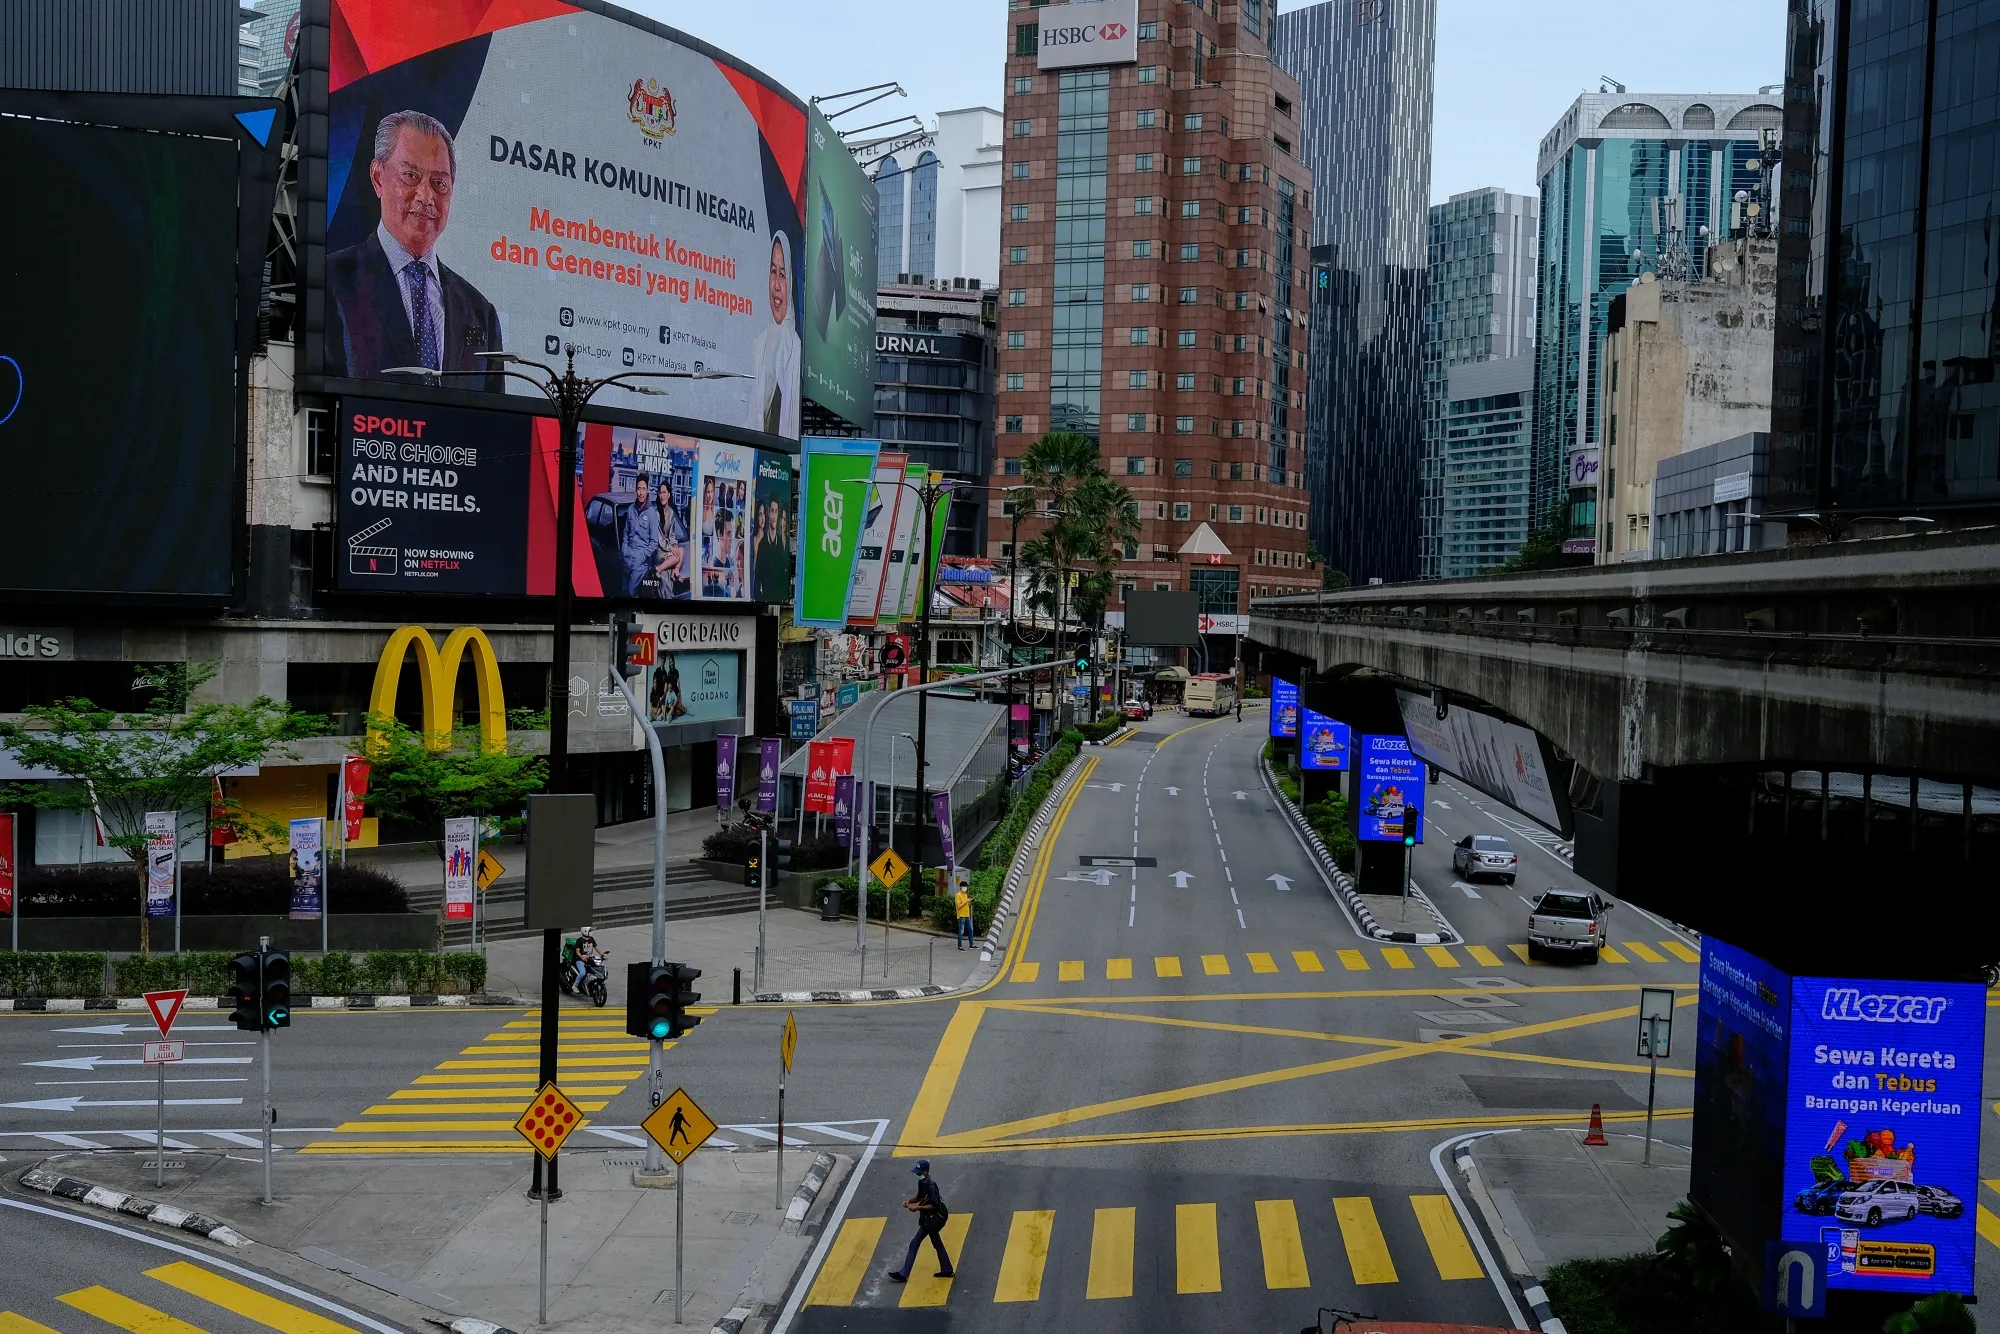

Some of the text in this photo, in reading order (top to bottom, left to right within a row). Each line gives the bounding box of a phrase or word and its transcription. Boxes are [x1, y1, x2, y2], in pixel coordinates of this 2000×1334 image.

[1042, 25, 1096, 46] HSBC
[643, 137, 662, 149] KPKT
[490, 134, 756, 234] DASAR KOMUNITI NEGARA
[529, 206, 736, 280] Membentuk Komuniti
[490, 235, 753, 316] dan Generasi yang Mampan
[578, 315, 650, 337] www.kpkt.gov.my
[672, 330, 717, 350] KPKT Malaysia
[637, 352, 687, 371] KPKT Malaysia
[353, 414, 426, 438] SPOILT
[352, 437, 477, 466] FOR CHOICE
[636, 439, 669, 458] ALWAYS
[351, 463, 459, 488] AND HEAD
[645, 456, 673, 474] MAYBE
[759, 465, 789, 481] Perfect Date
[350, 487, 481, 513] OVER HEELS.
[822, 480, 844, 557] acer
[404, 548, 474, 560] NOW SHOWING
[869, 549, 874, 557] 5
[404, 560, 460, 570] ON NETFLIX
[658, 621, 740, 645] GIORDANO
[691, 691, 729, 702] GIORDANO
[1369, 757, 1417, 766] Sewa Kereta
[1367, 774, 1391, 782] Barangan
[1708, 951, 1724, 976] Sewa
[1725, 960, 1743, 988] Kereta
[1745, 972, 1757, 996] dan
[1702, 973, 1782, 1041] Barangan Keperluan Harian
[1821, 987, 1947, 1024] KLezcar
[153, 1052, 175, 1060] LALUAN
[158, 1044, 171, 1052] BERI
[1814, 1045, 1956, 1069] Sewa Kereta
[1832, 1071, 1937, 1092] dan Tebus
[1805, 1095, 1961, 1116] Barangan Keperluan
